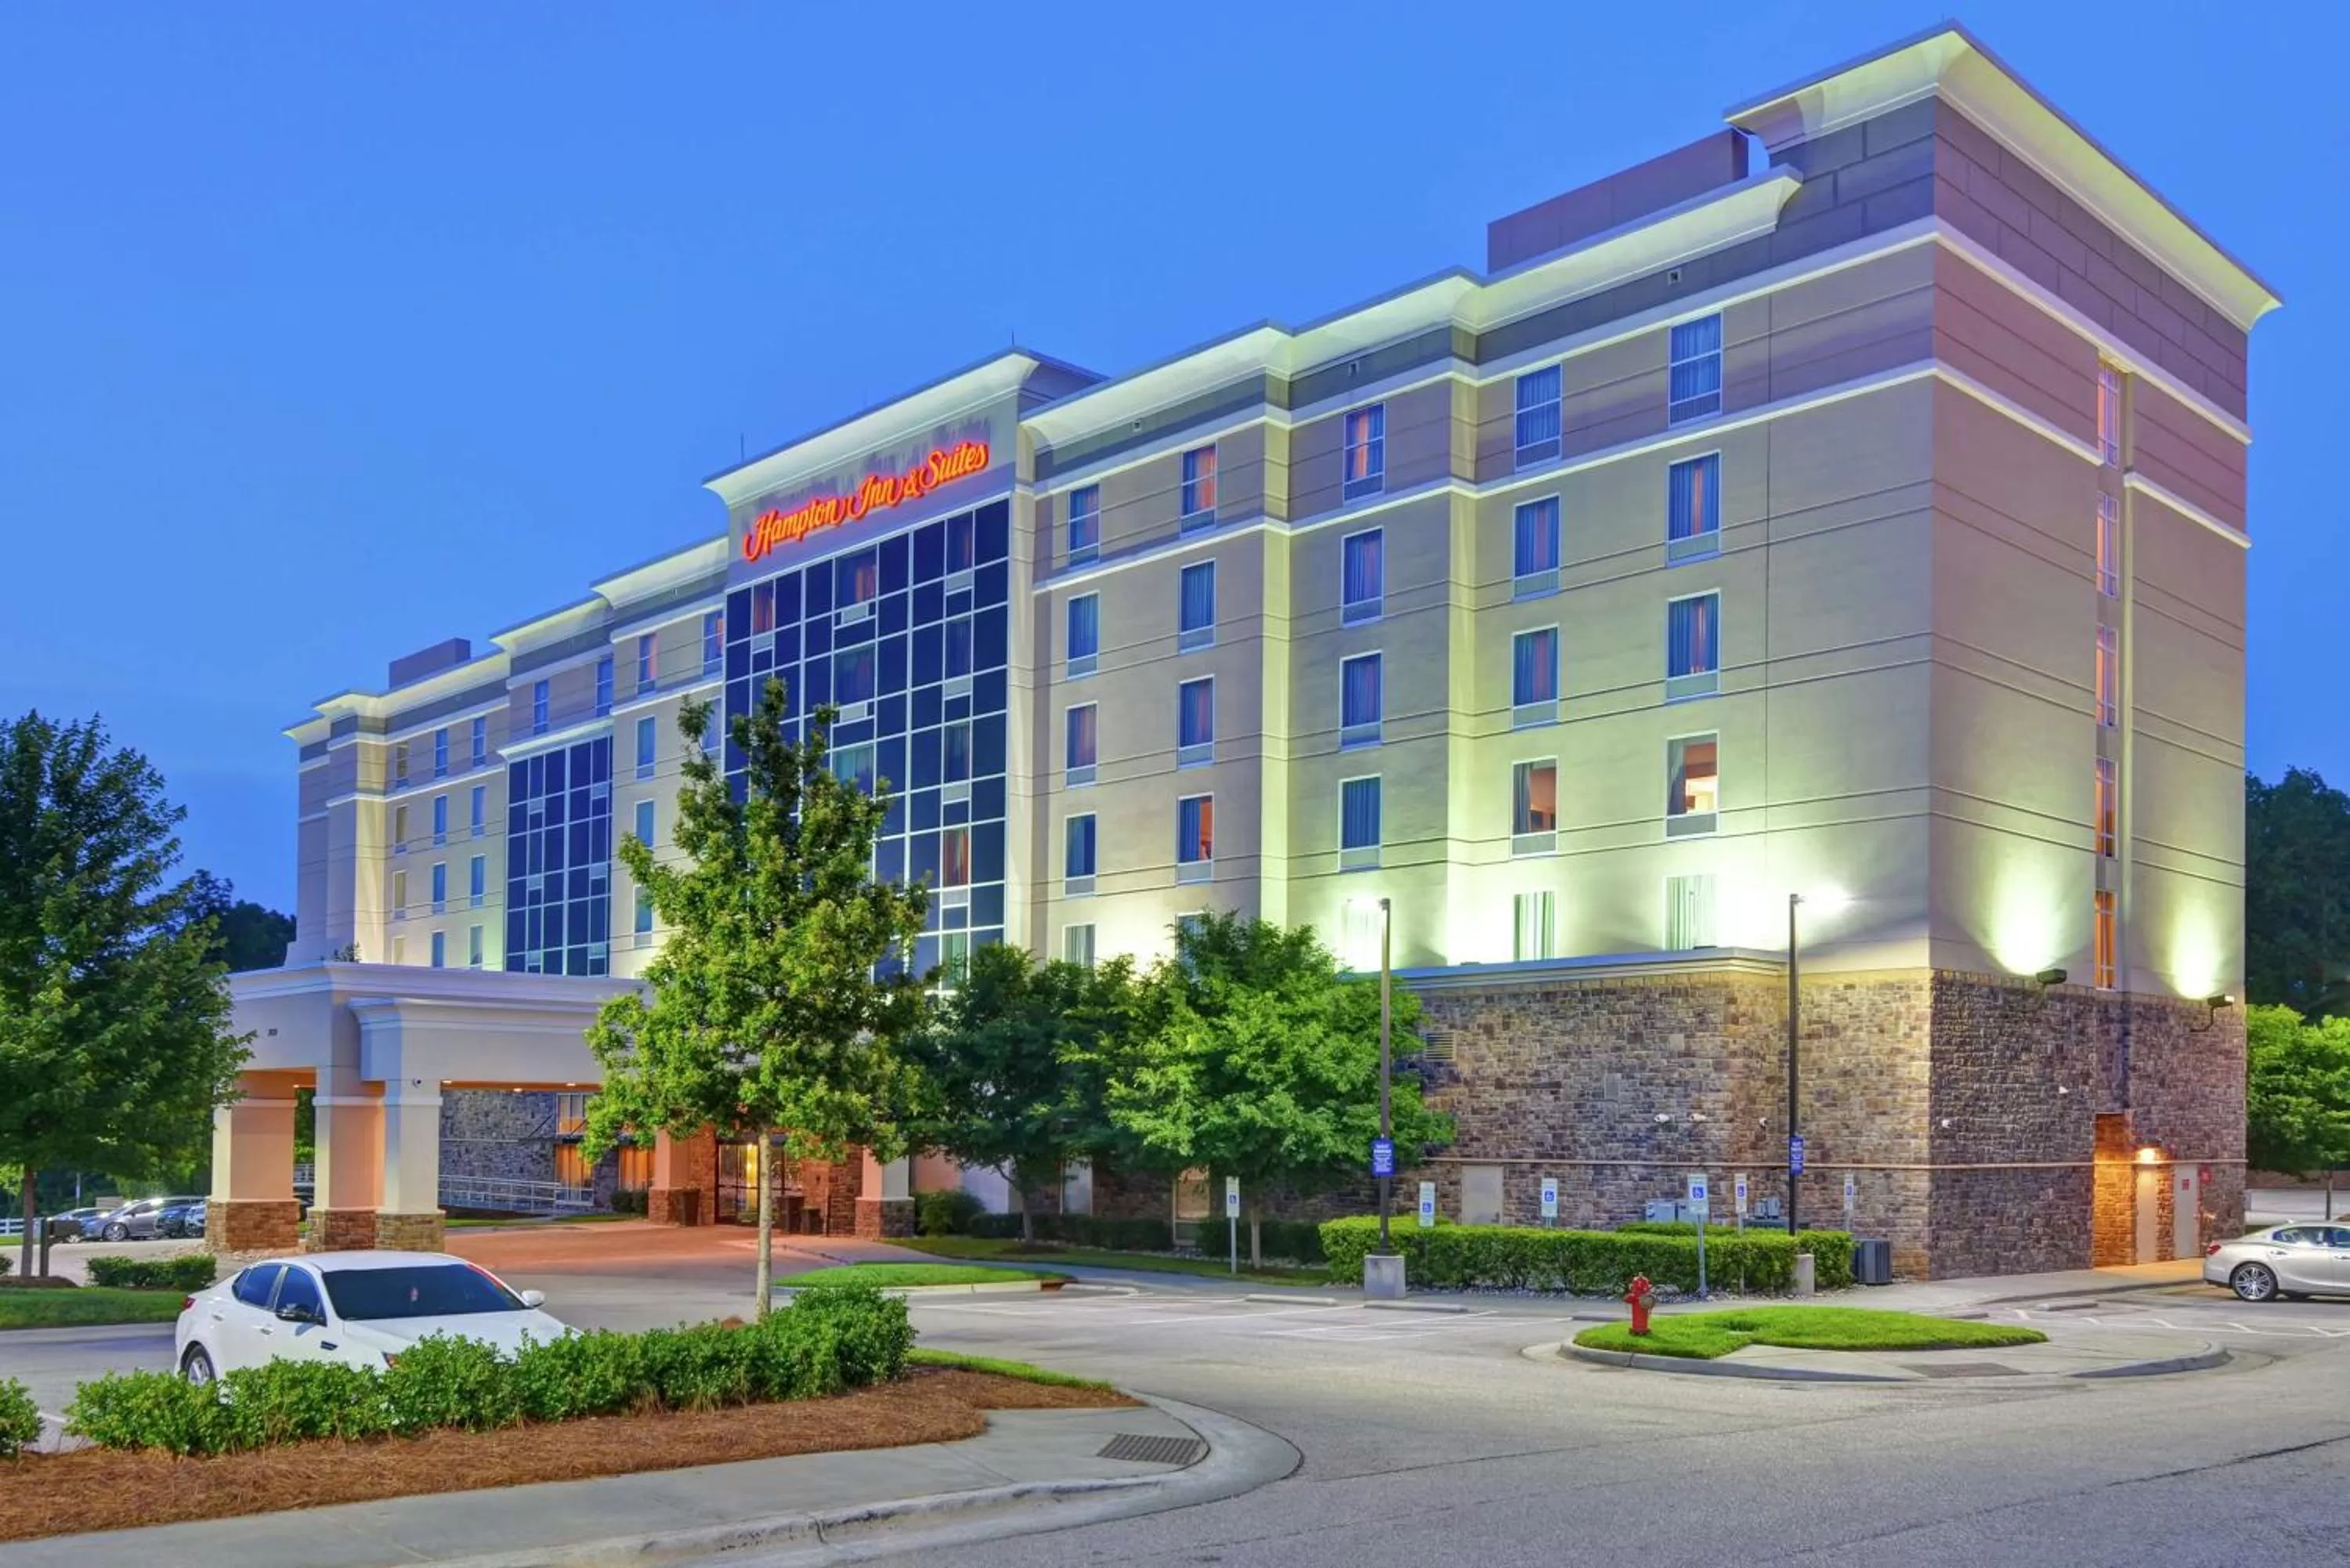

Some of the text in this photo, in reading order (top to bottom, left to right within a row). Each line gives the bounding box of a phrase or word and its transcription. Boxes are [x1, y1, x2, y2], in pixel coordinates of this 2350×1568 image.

[743, 442, 989, 562] Hampton Inn & Suites
